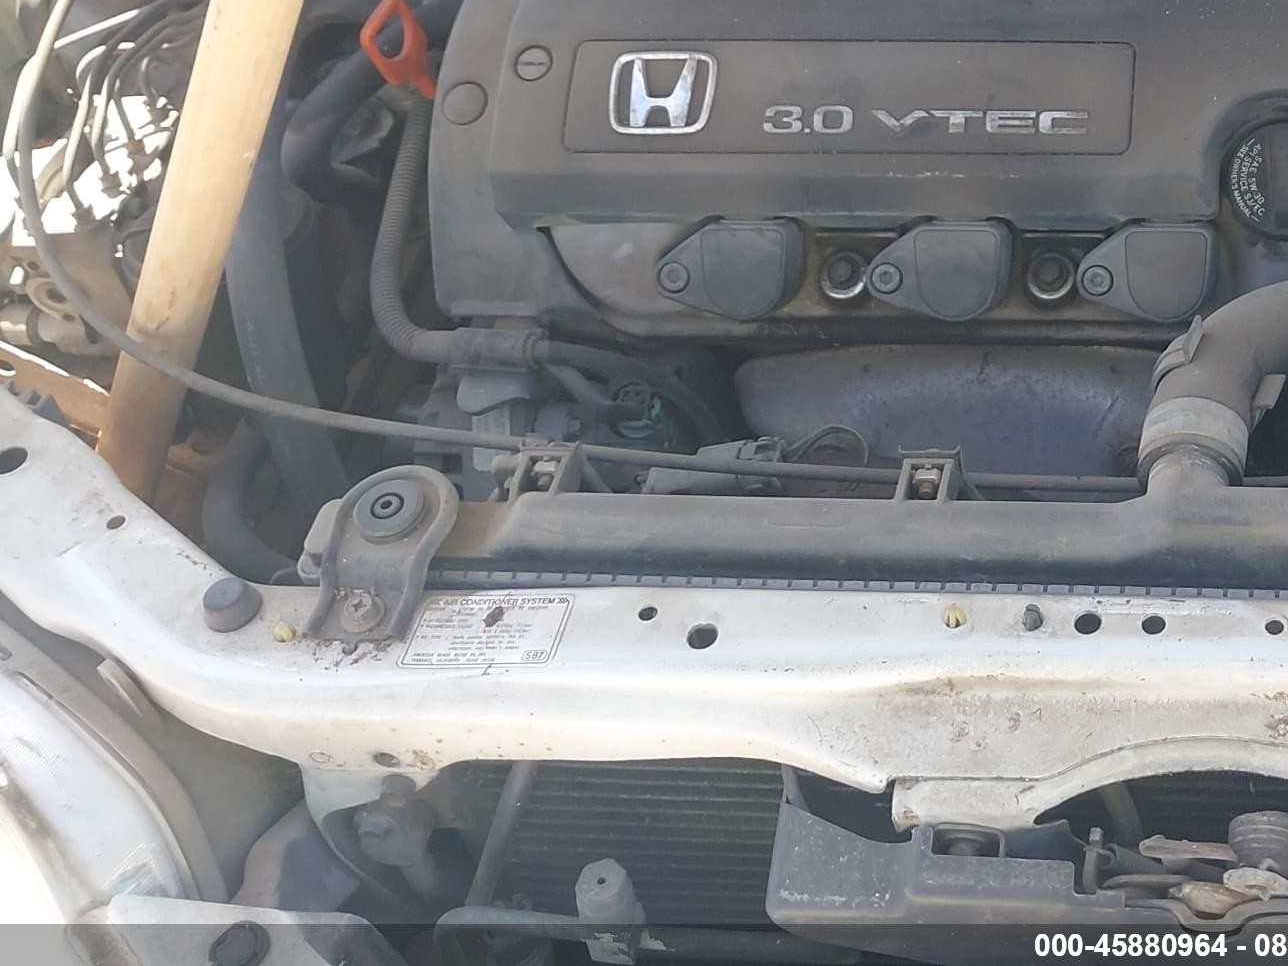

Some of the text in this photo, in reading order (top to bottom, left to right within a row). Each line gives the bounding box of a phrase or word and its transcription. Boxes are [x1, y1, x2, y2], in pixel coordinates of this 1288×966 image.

[763, 105, 1089, 135] 3.0 VTEC
[1240, 155, 1252, 192] SERVICE
[1248, 155, 1262, 173] SAE
[460, 597, 518, 607] CONDITIONER
[520, 597, 556, 606] SYSTEM
